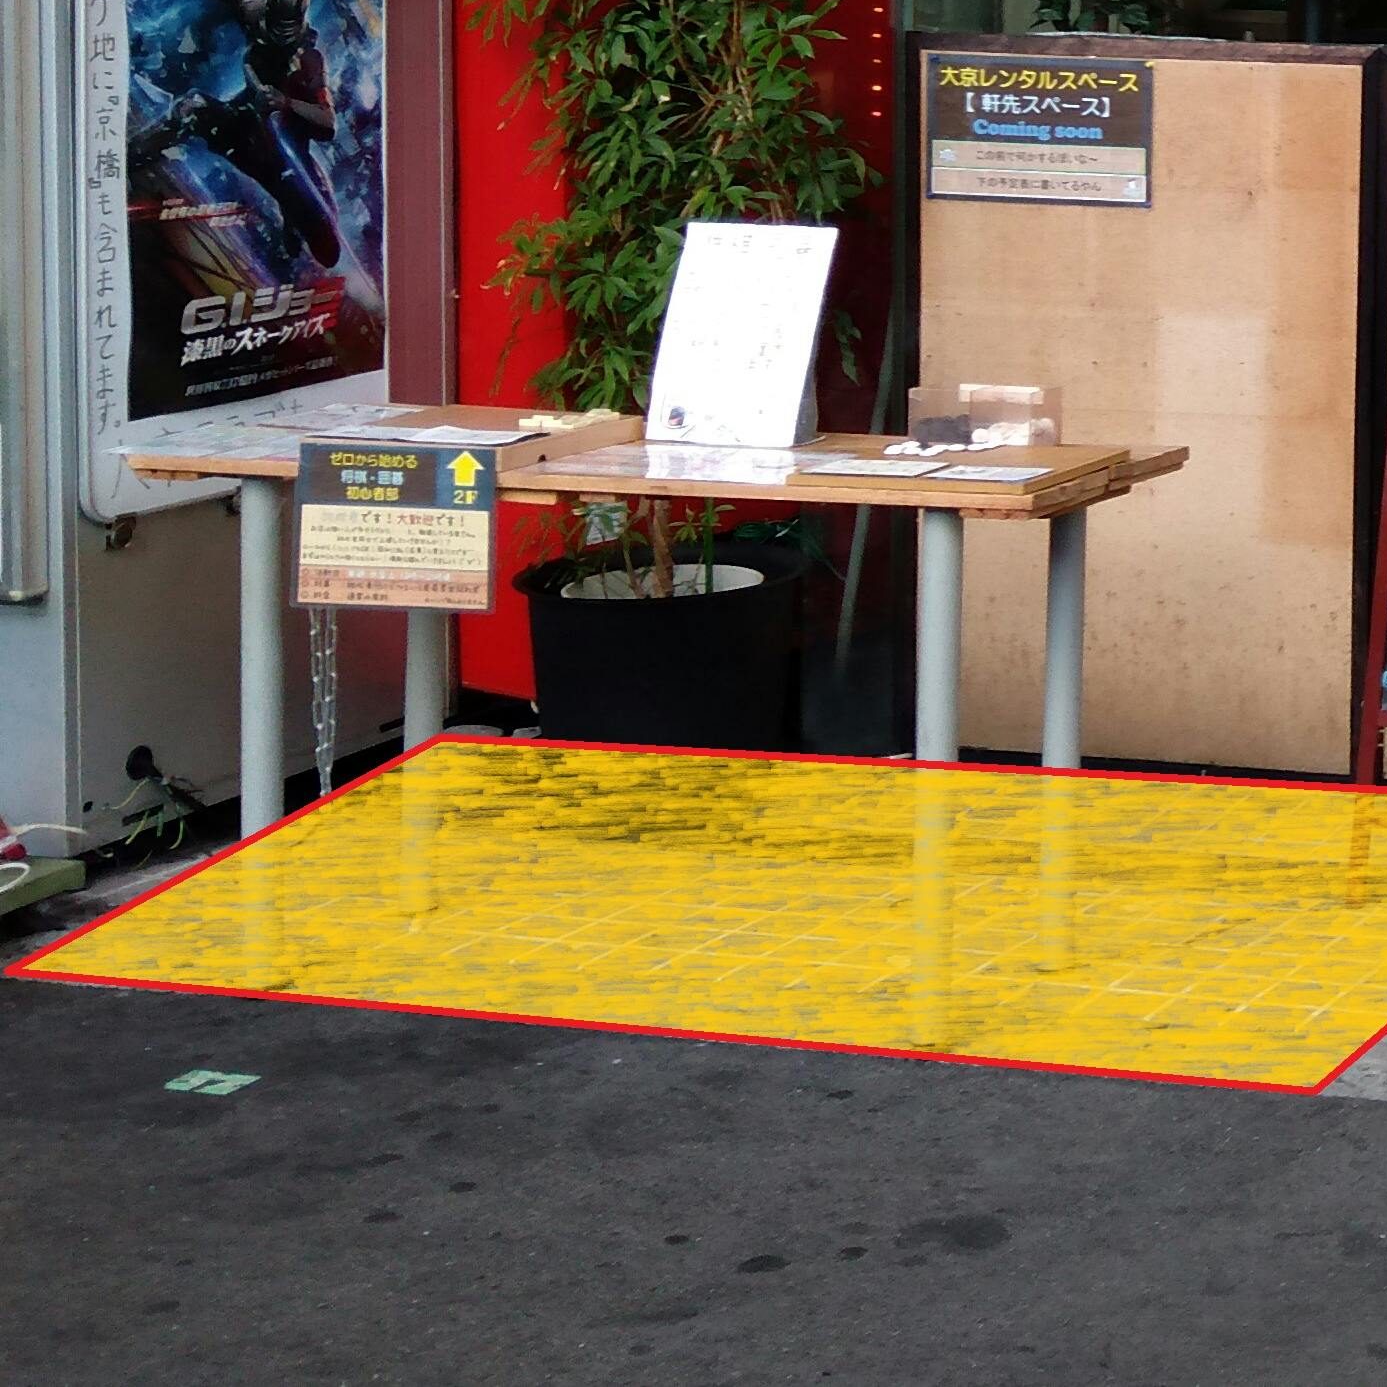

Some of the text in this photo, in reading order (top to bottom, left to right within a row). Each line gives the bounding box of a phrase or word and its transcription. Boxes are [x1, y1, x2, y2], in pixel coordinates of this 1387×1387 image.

[939, 66, 1139, 93] 大京レンタルスペース
[973, 118, 1104, 141] Coming soon
[180, 314, 332, 367] 漆黒のスネークアイズ
[330, 452, 418, 469] ゼロから始める
